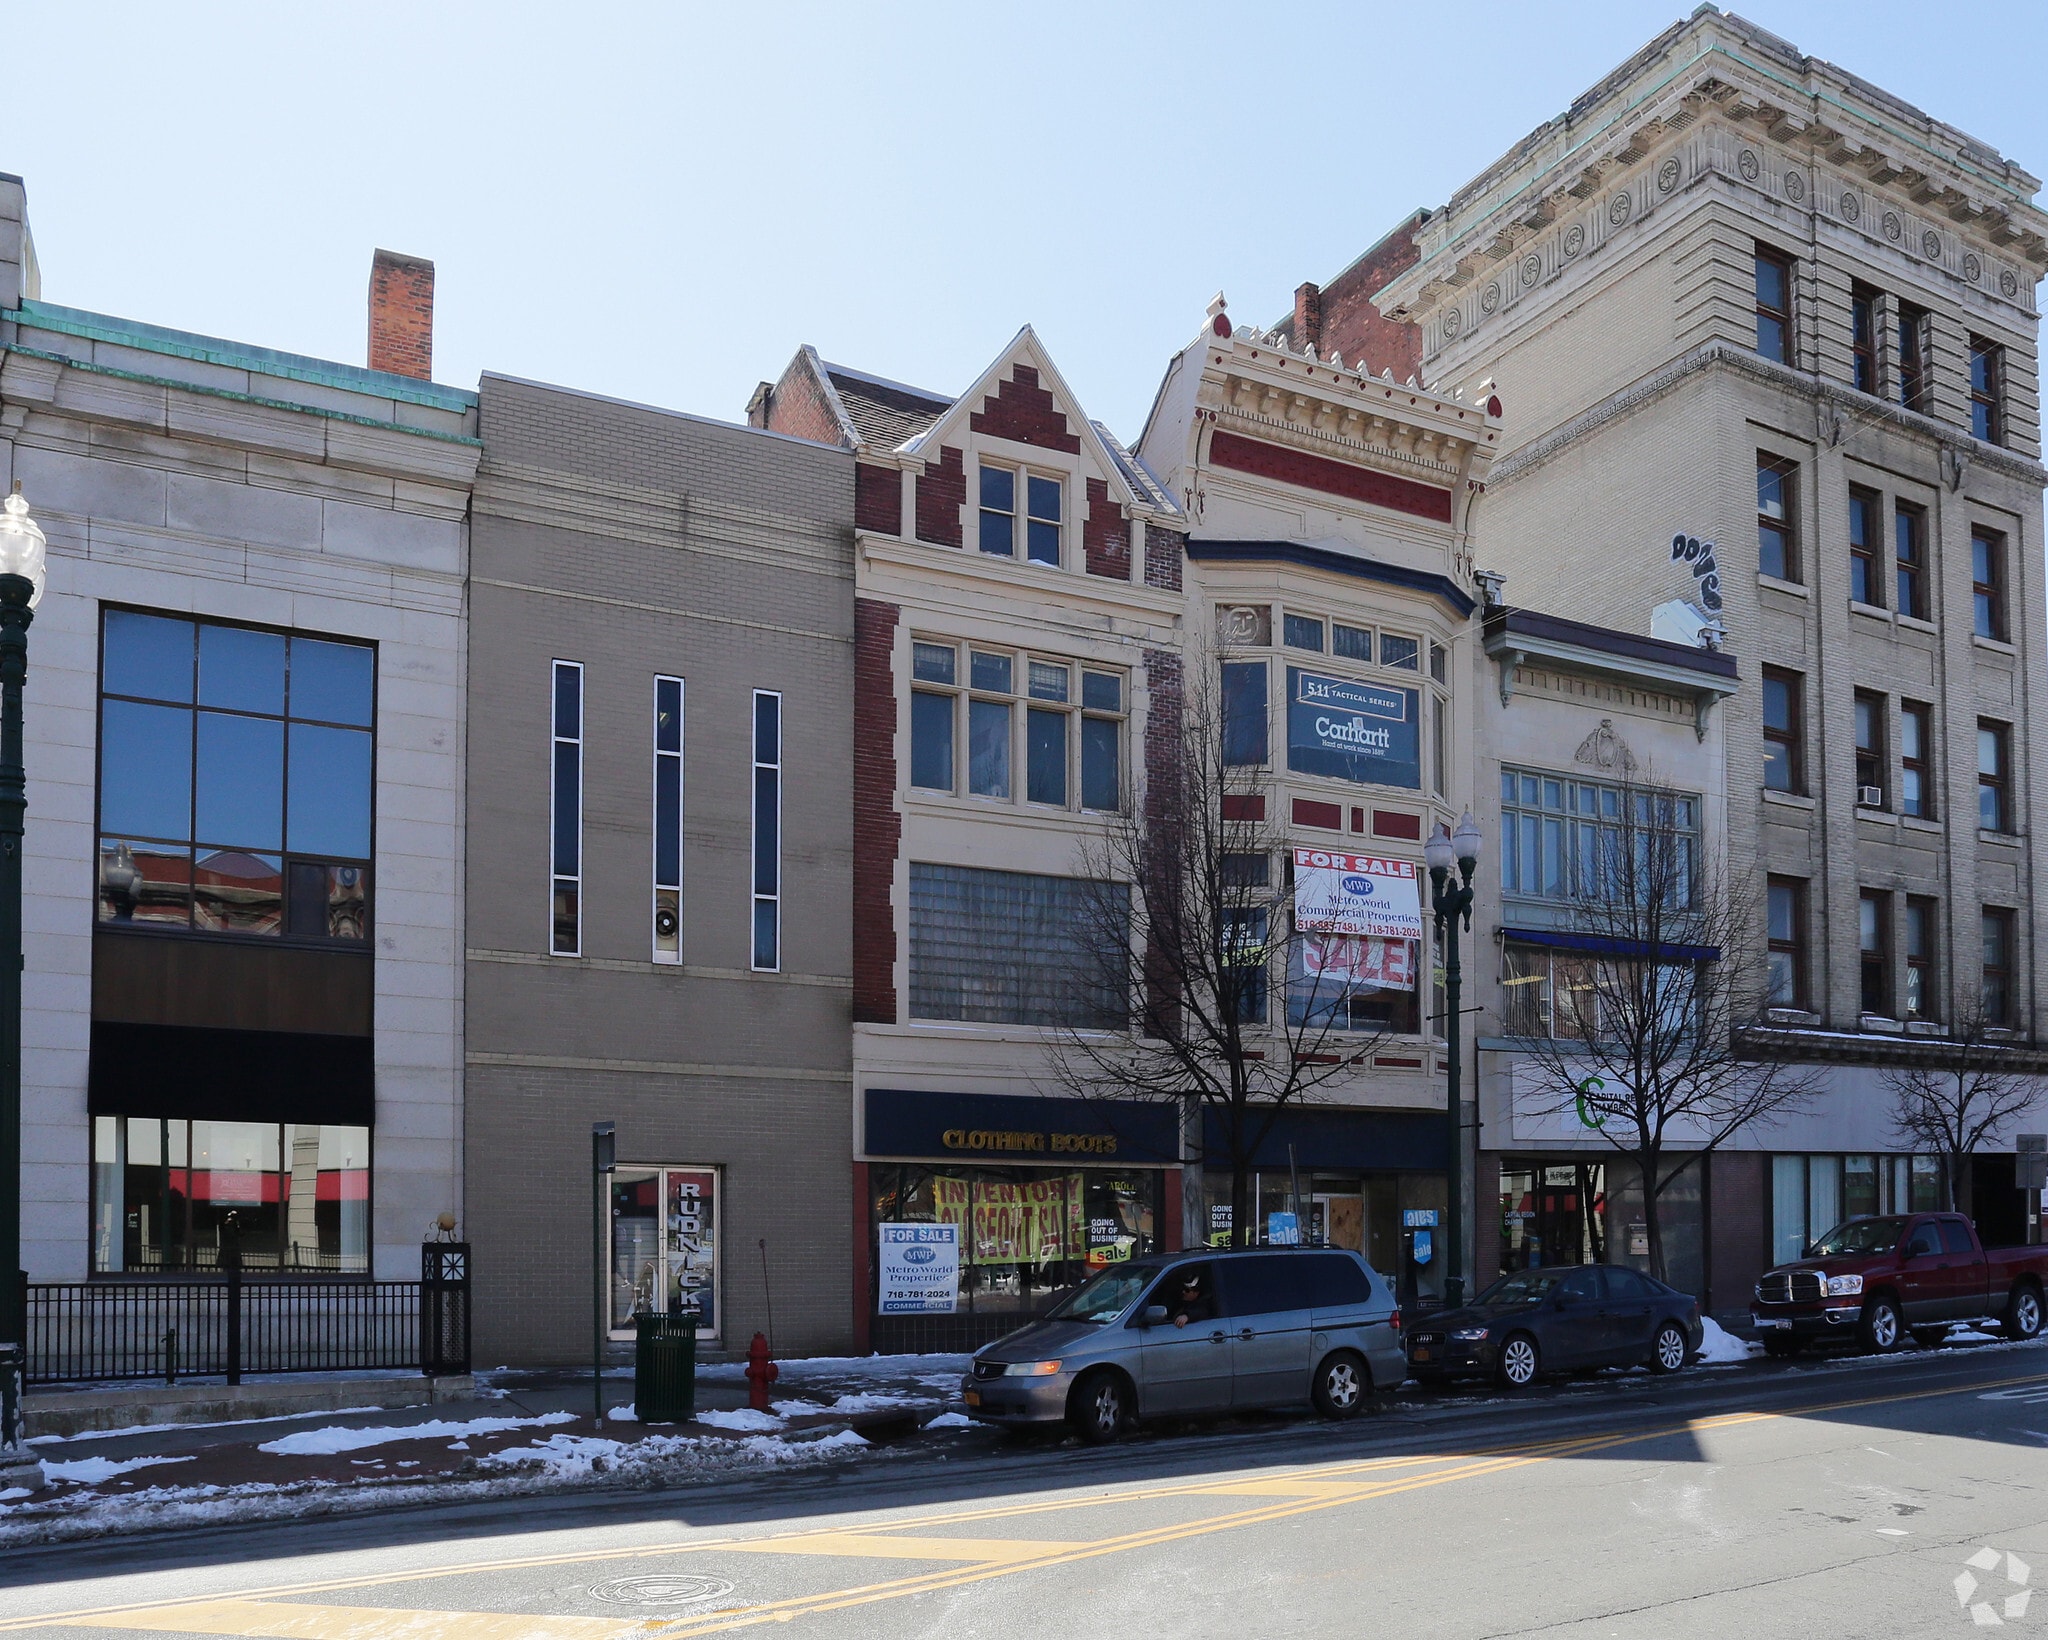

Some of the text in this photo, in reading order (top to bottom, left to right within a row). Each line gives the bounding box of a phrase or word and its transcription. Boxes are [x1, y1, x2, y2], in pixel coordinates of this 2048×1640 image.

[1307, 681, 1330, 698] 5.11
[1331, 690, 1367, 703] TACTICAL
[1315, 716, 1390, 749] Carhartt
[1297, 850, 1413, 878] FOR SALE
[1344, 878, 1372, 893] MWP
[1328, 895, 1391, 910] Metro World
[1297, 905, 1420, 925] Commercial Properties
[1367, 923, 1421, 938] 718-781-2024
[942, 1129, 1118, 1154] CLOTHING BOOTS
[939, 1177, 1081, 1204] INVENTORY
[1091, 1218, 1115, 1226] GOING
[888, 1229, 951, 1242] FOR SALE
[678, 1183, 701, 1316] RUDNICK
[907, 1250, 933, 1260] MWP
[1096, 1245, 1127, 1262] sale
[886, 1265, 953, 1274] Metro World
[890, 1274, 949, 1283] Properties
[887, 1291, 951, 1299] 718-781-2024
[886, 1302, 950, 1310] COMMERCIAL
